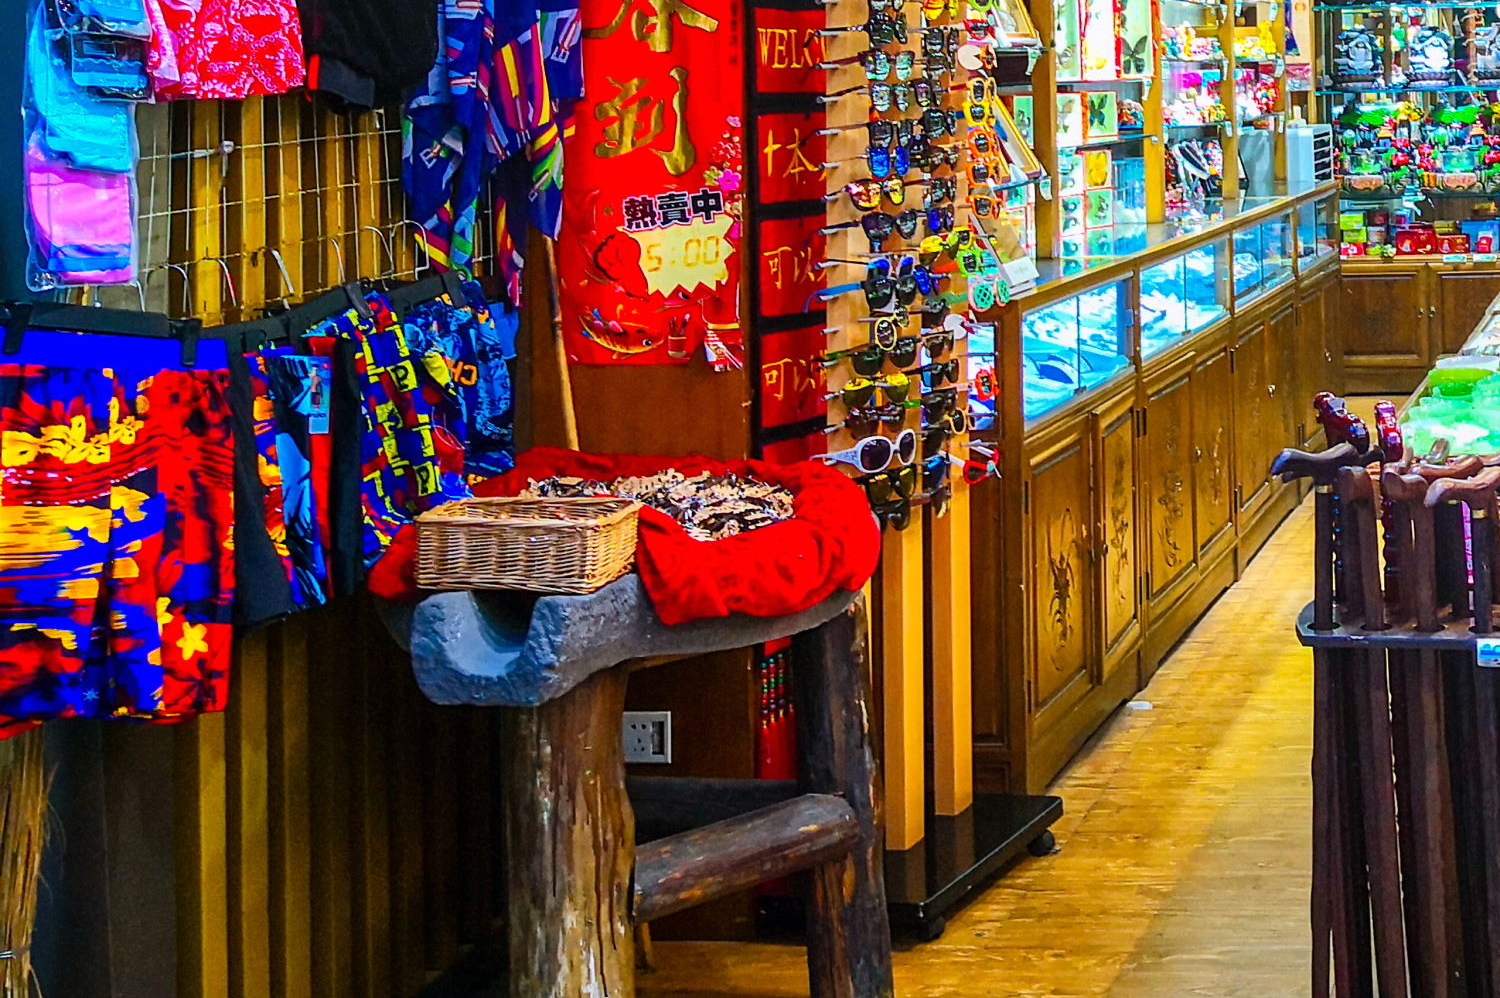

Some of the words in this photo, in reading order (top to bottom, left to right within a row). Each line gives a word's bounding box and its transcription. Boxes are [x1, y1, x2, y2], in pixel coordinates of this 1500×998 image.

[624, 189, 723, 230] 熱賣中
[763, 246, 827, 289] 可以
